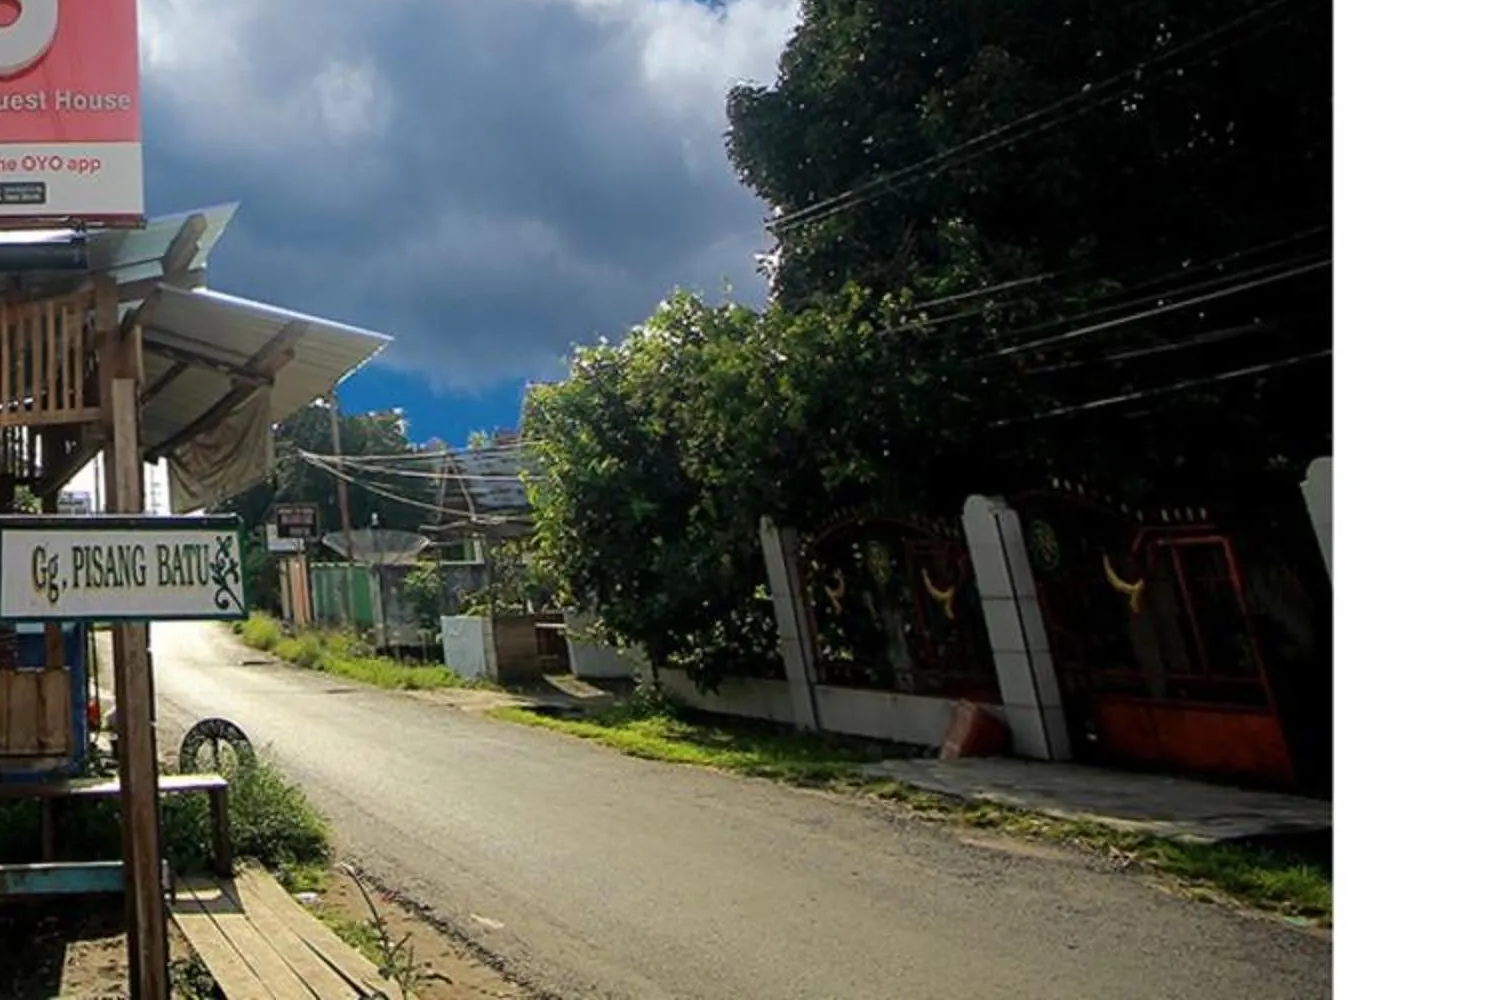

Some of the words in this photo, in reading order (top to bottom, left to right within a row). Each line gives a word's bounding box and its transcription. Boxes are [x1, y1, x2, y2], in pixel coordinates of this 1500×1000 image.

[55, 89, 132, 111] House
[21, 155, 63, 171] OYO
[67, 158, 101, 175] app
[72, 544, 146, 588] PISANG
[157, 543, 209, 586] BATU
